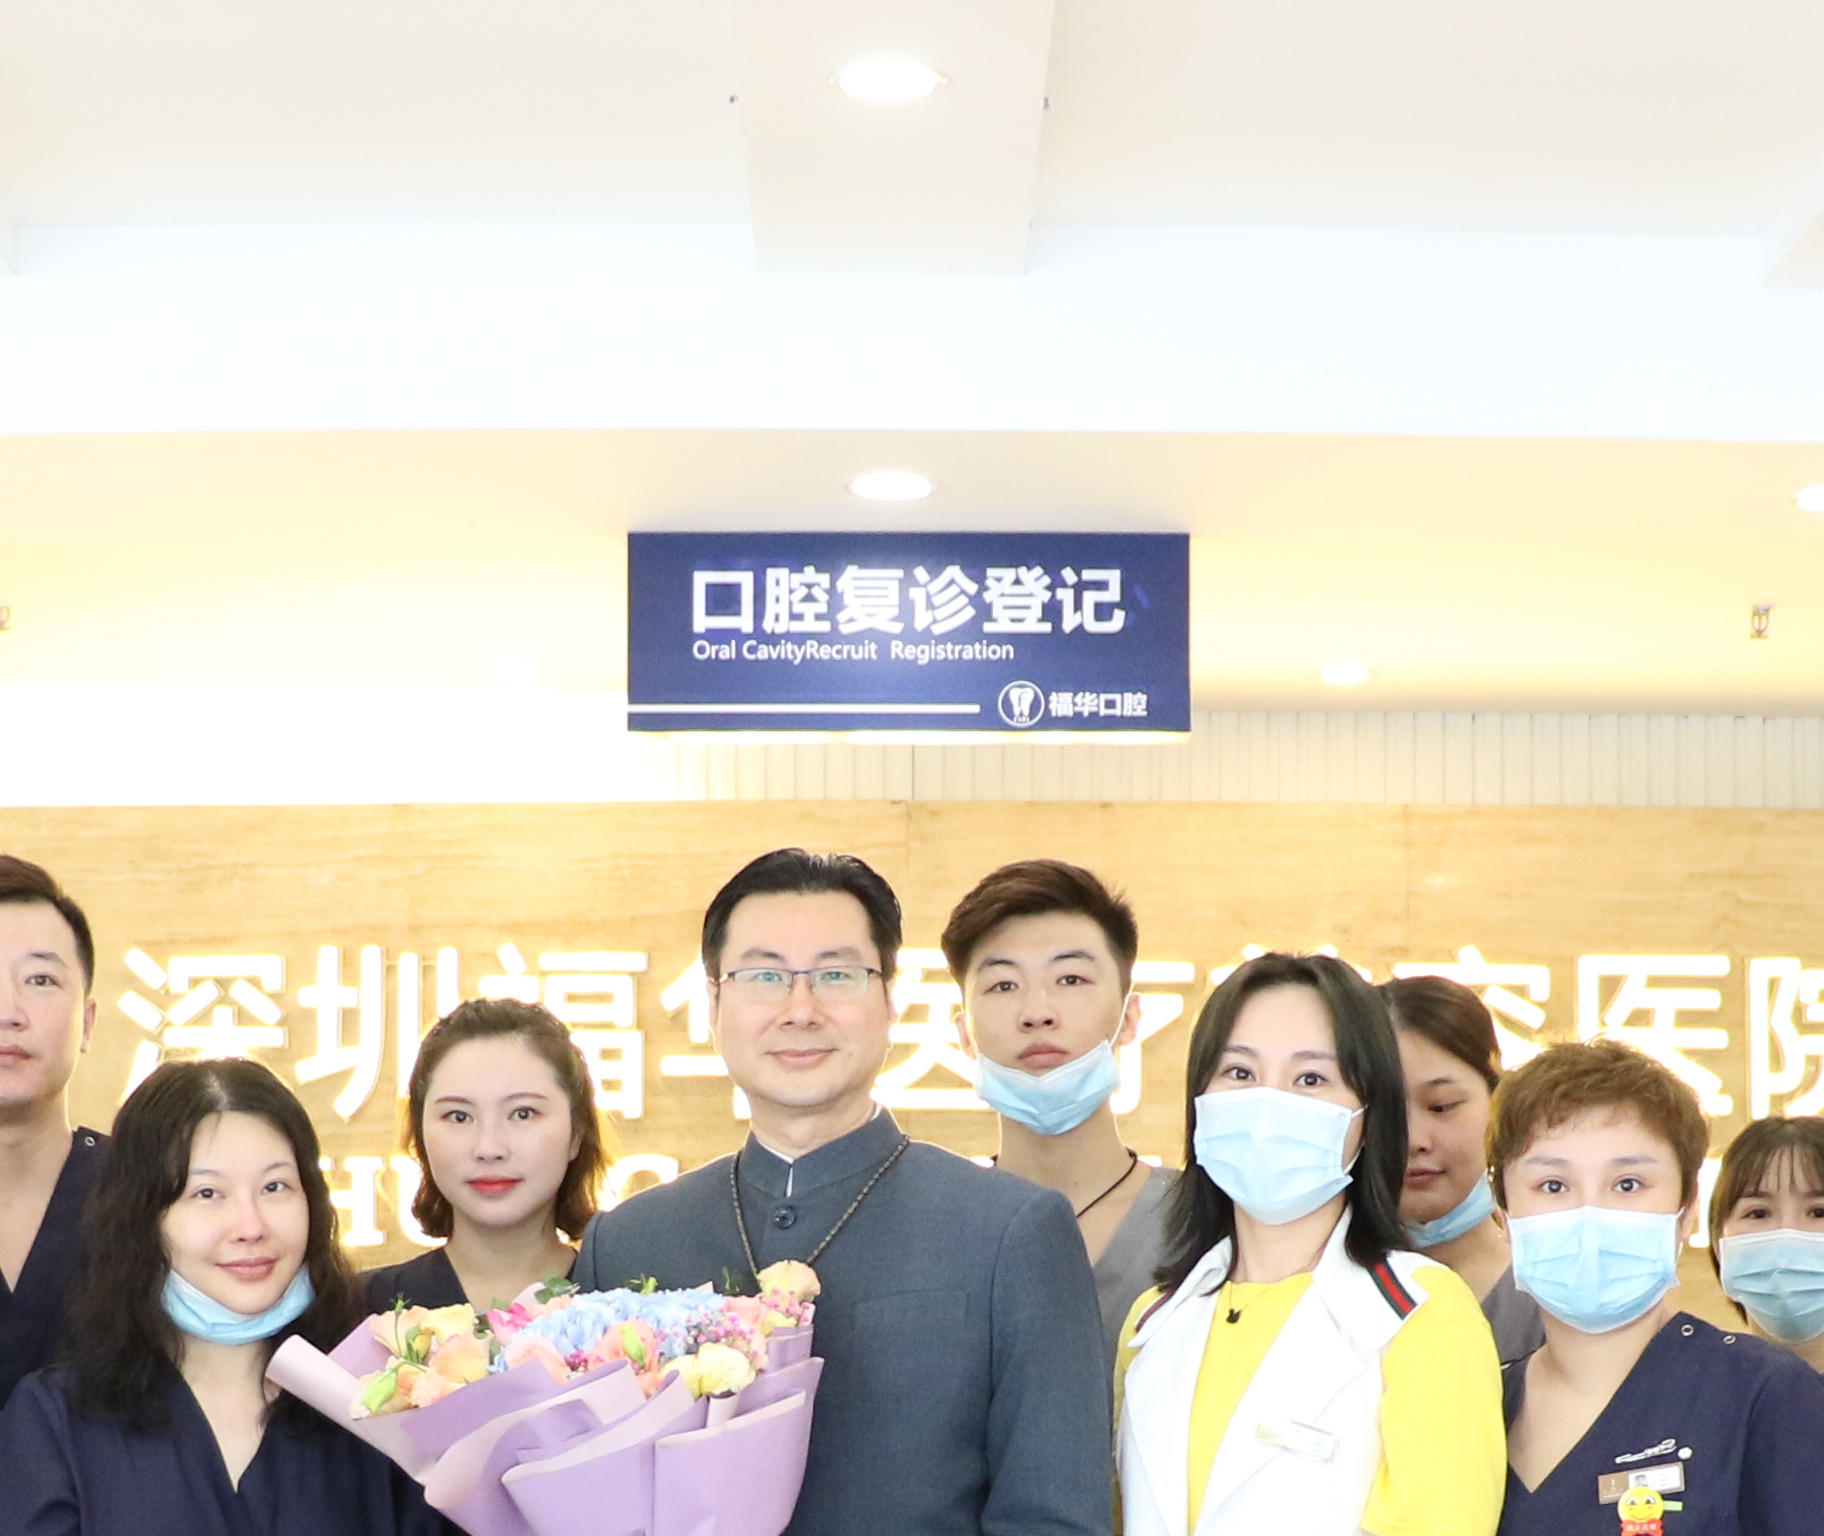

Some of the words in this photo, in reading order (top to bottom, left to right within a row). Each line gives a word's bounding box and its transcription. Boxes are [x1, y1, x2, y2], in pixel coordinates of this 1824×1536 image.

[691, 565, 1126, 636] 口腔复诊登记
[693, 640, 736, 661] Oral
[890, 639, 1014, 665] Registration
[1049, 692, 1148, 717] 福华口腔
